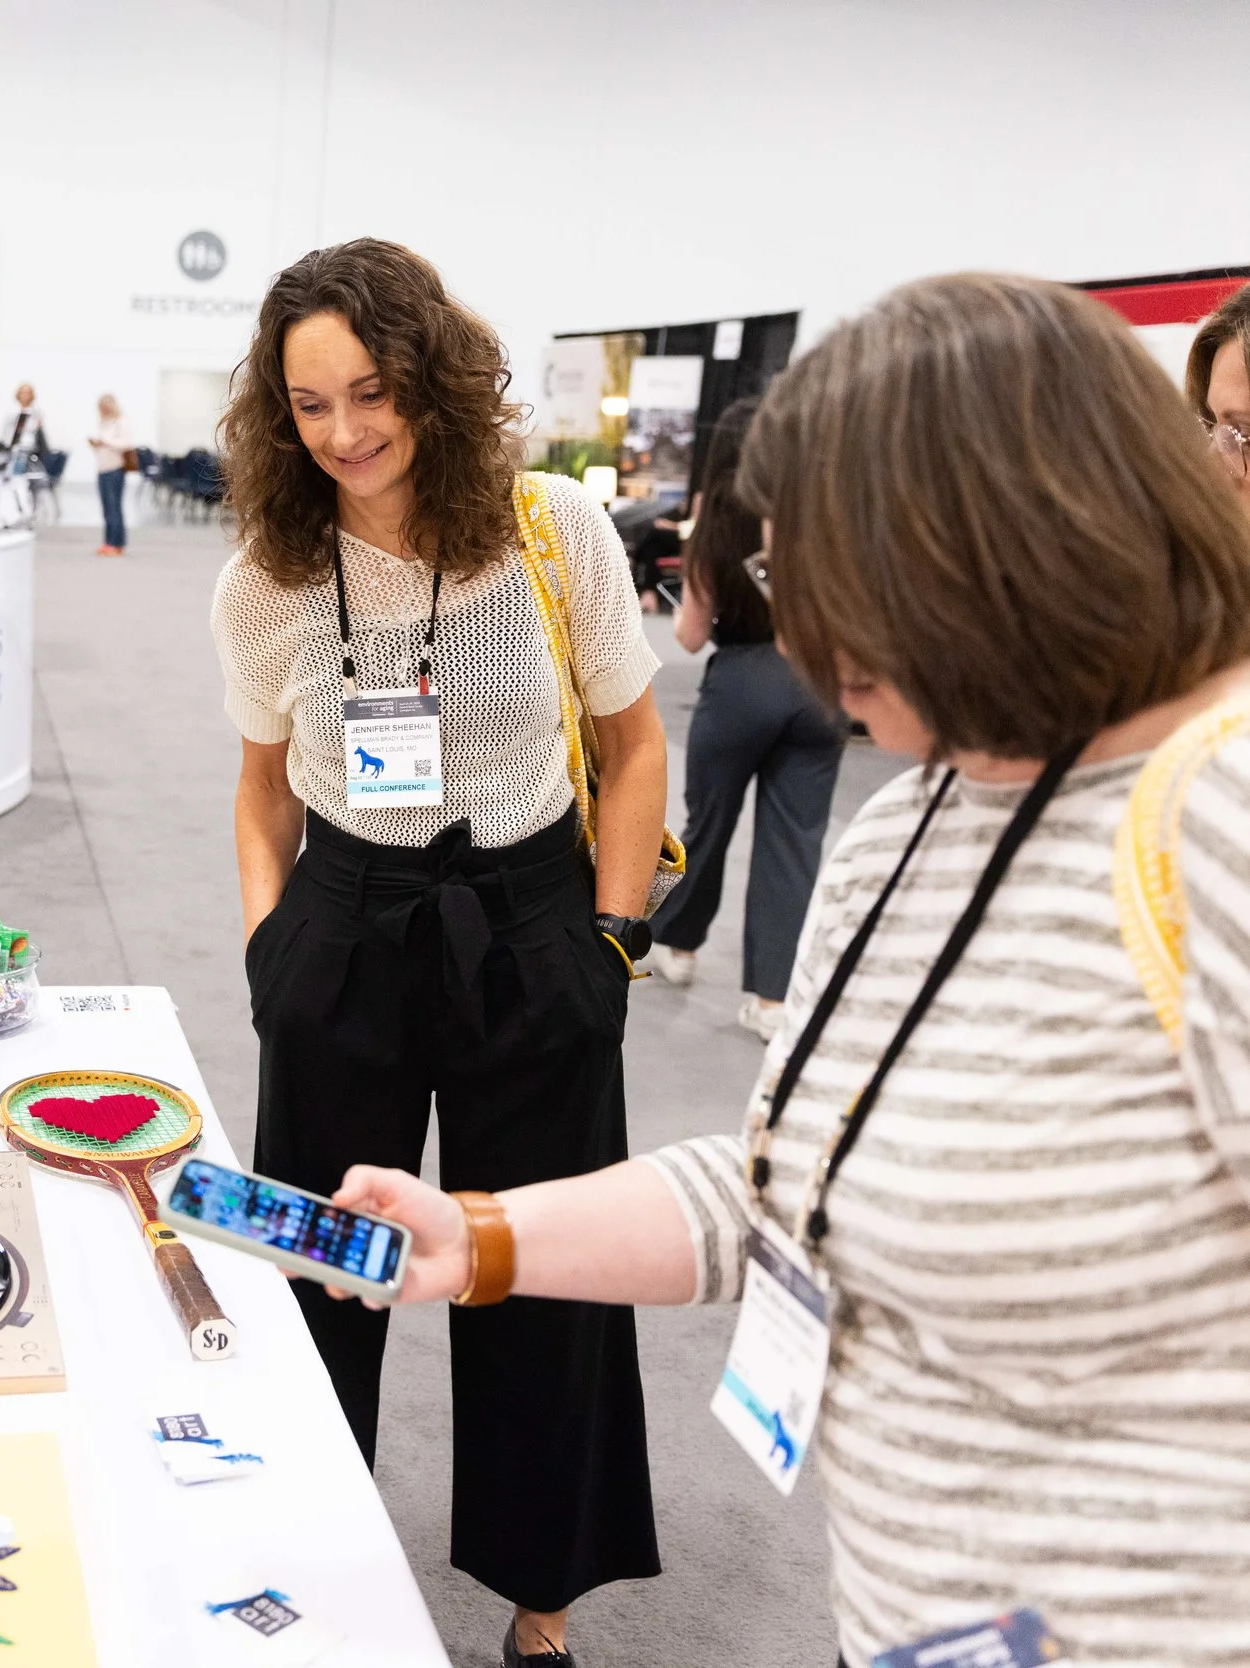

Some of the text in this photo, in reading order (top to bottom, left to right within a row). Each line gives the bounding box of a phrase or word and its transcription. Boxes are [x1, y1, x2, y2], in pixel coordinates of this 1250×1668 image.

[351, 724, 431, 734] JENNIFER SHEEHAN
[379, 784, 426, 792] CONFERENCE
[83, 1147, 161, 1158] SNAUWAERT
